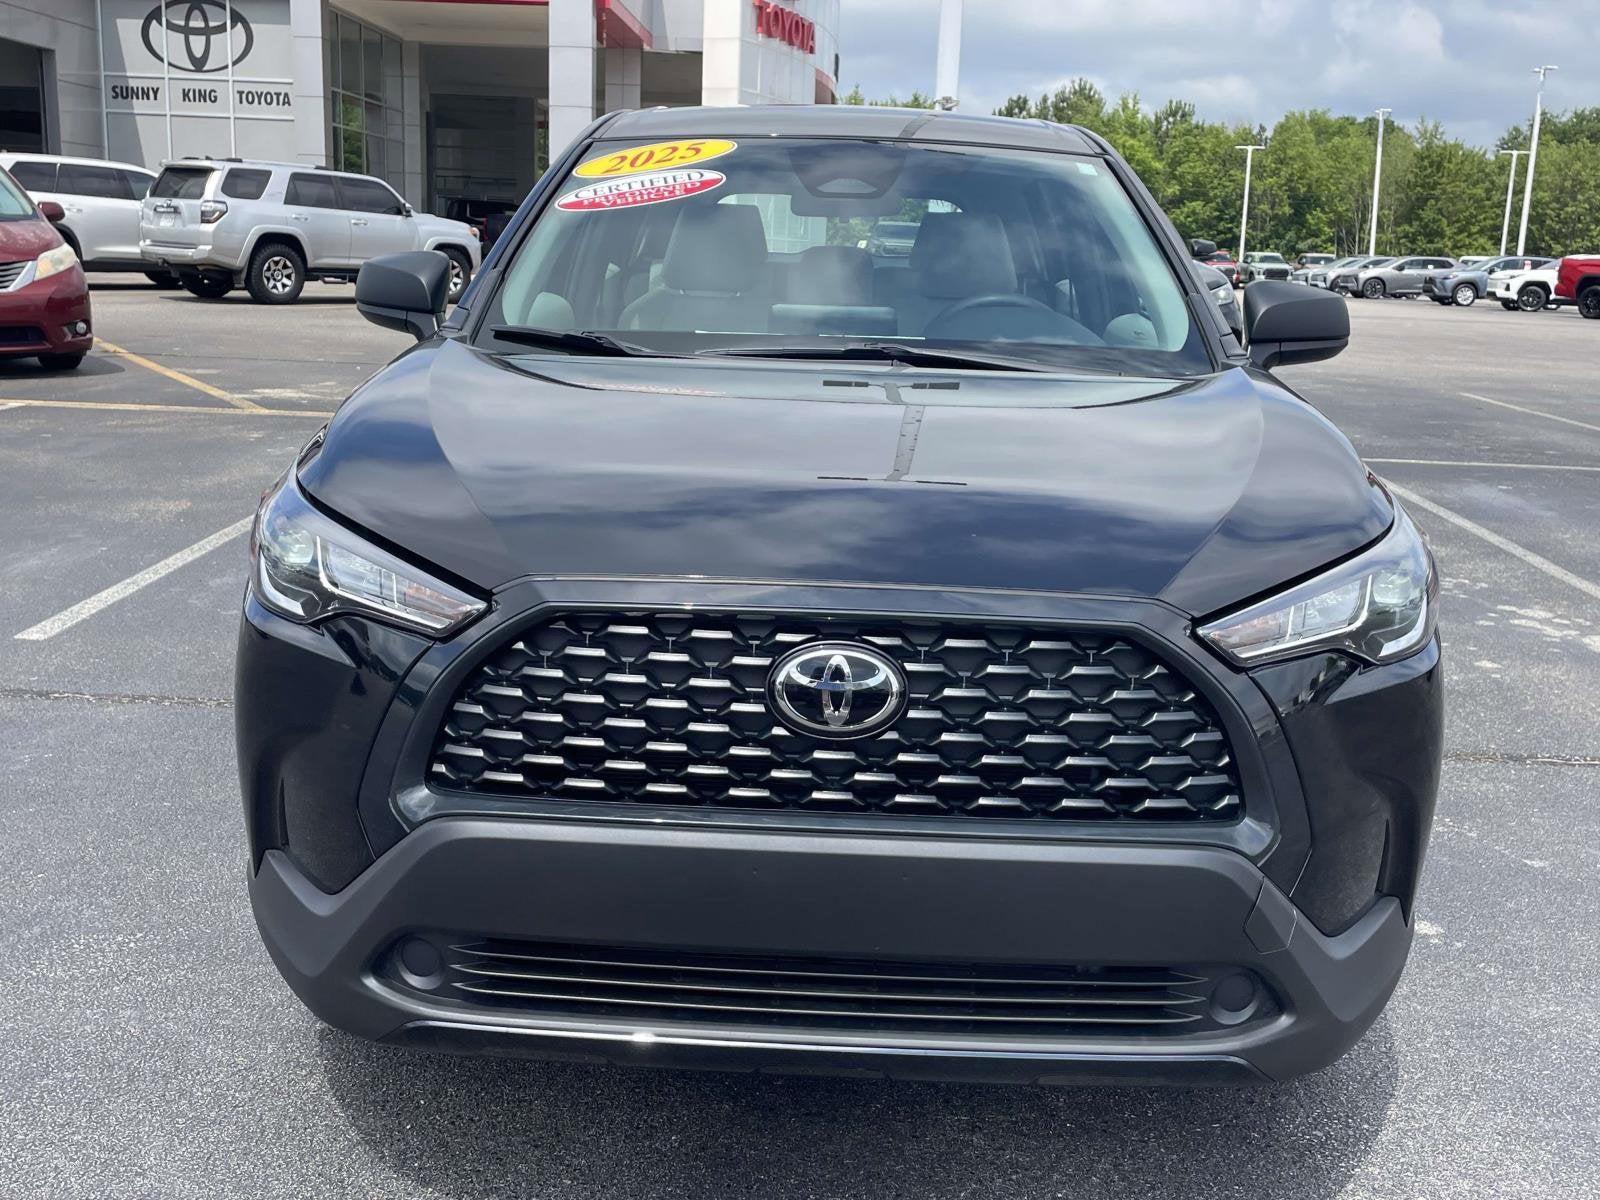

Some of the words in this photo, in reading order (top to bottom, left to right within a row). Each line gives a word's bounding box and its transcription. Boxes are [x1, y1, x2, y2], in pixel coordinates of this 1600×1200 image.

[754, 0, 815, 54] TOYOTA
[111, 85, 160, 101] SUNNY
[182, 88, 218, 104] KING
[237, 90, 291, 106] TOYOTA
[602, 142, 706, 174] 2025
[575, 171, 704, 199] CERTIFIED
[583, 181, 701, 206] PRE-OWNED
[603, 187, 687, 206] VEHICLE
